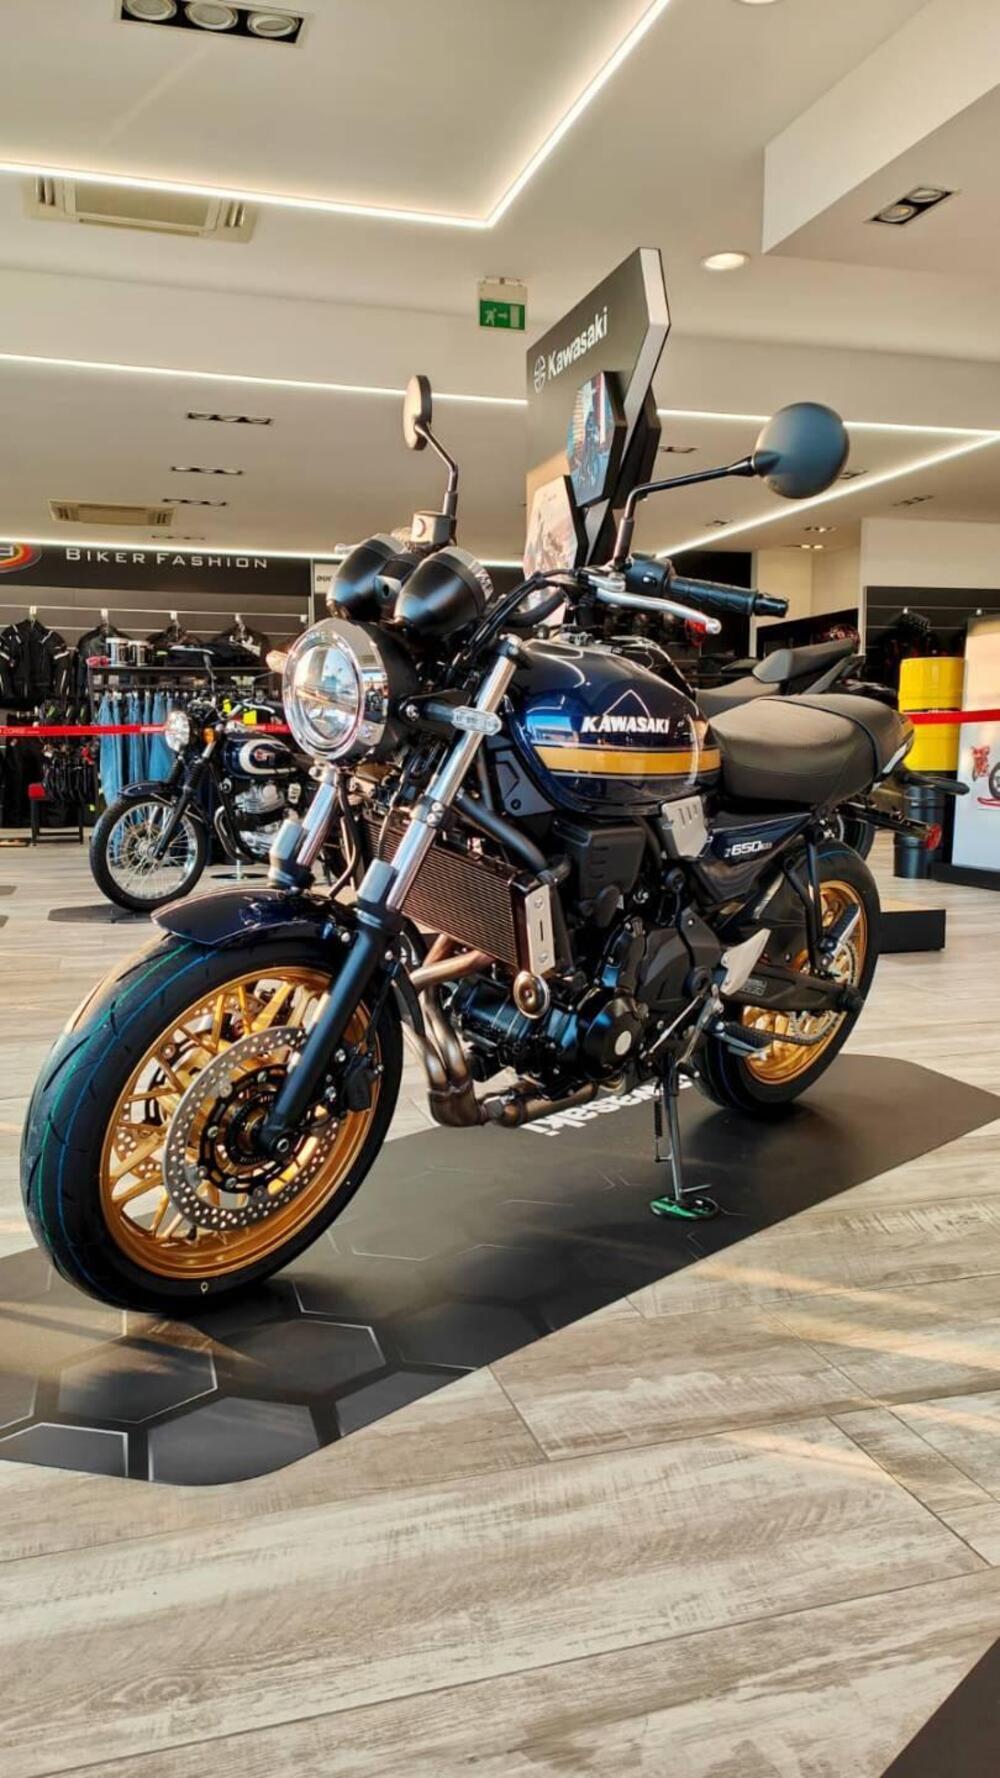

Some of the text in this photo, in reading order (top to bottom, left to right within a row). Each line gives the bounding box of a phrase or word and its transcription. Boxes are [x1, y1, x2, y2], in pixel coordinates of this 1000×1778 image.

[547, 305, 608, 380] Kawasaki
[65, 547, 268, 569] BIKER FASHION
[581, 715, 670, 734] KAWASAKI
